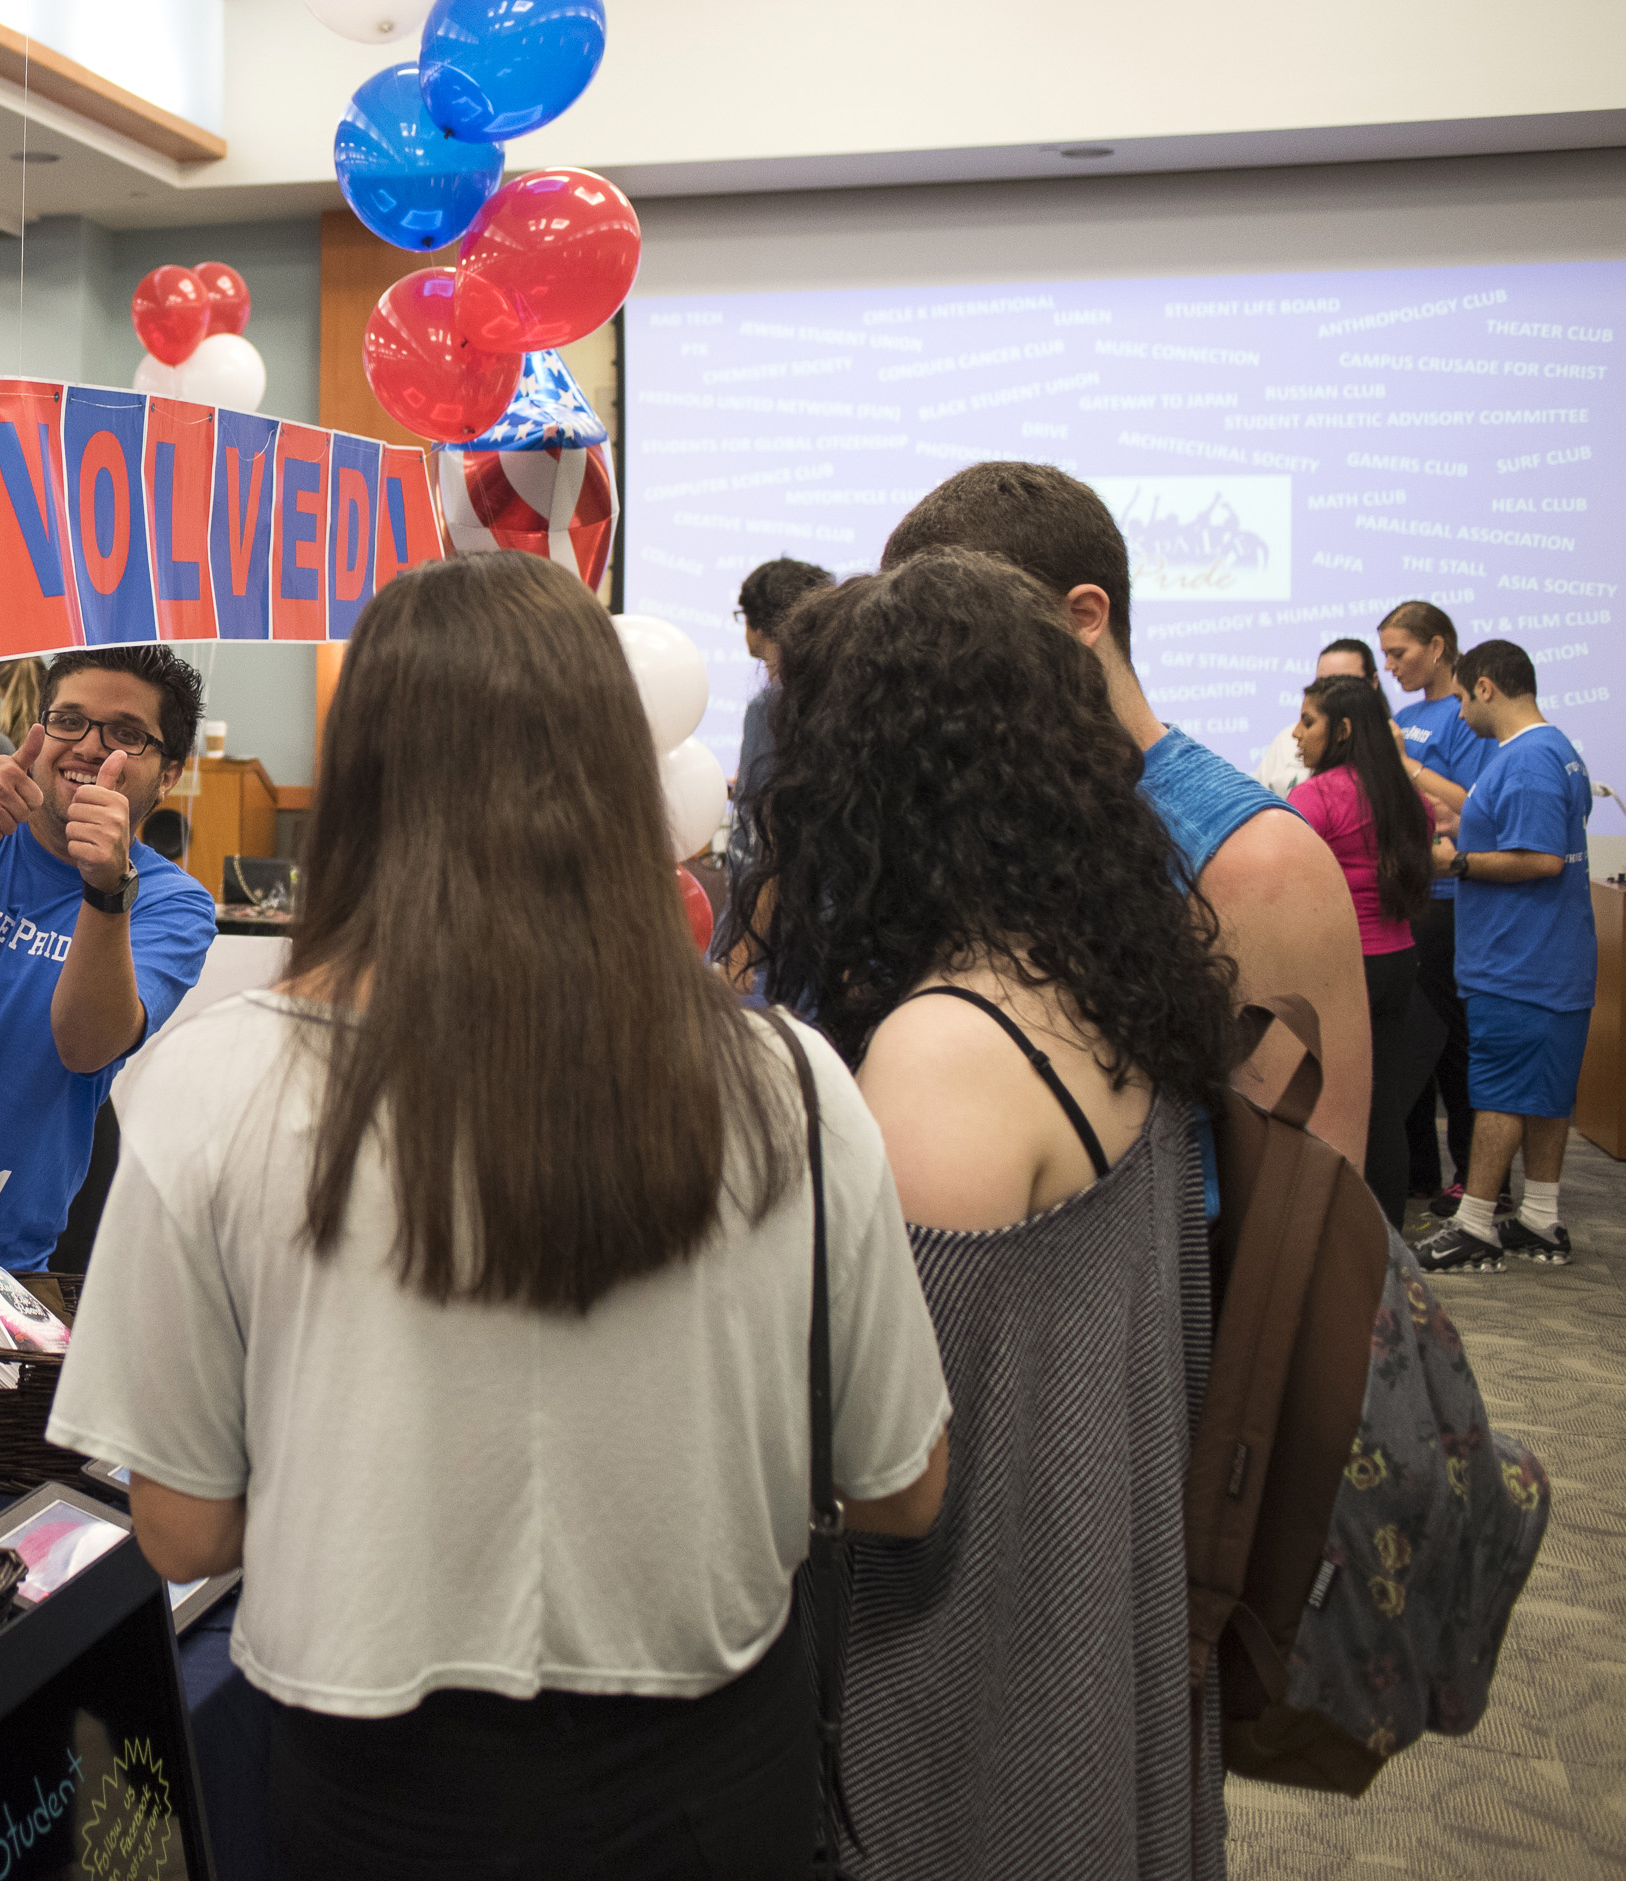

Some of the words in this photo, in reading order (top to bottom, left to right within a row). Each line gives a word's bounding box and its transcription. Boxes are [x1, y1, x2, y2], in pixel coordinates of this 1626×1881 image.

[685, 310, 723, 325] TECH
[863, 306, 912, 326] CIRCLE
[931, 294, 1056, 320] INTERNATIONAL
[1054, 309, 1112, 326] LUMEN
[1164, 301, 1239, 319] STUDENT
[1243, 301, 1275, 317] LIFE
[1280, 297, 1341, 315] BOARD
[1317, 298, 1459, 340] ANTHROPOLOGY
[1463, 288, 1508, 310] CLUB
[798, 327, 866, 346] STUDENT
[870, 333, 923, 352] UNION
[1486, 318, 1563, 339] THEATER
[1567, 325, 1614, 343] CLUB
[878, 356, 956, 383] CONQUER
[958, 346, 1021, 370] CANCER
[1024, 338, 1065, 358] CLUB
[1095, 338, 1148, 359] MUSIC
[1152, 343, 1261, 367] CONNECTION
[703, 362, 786, 385] CHEMISTRY
[791, 356, 853, 376] SOCIETY
[1339, 352, 1414, 372] CAMPUS
[1418, 356, 1499, 375] CRUSADE
[1504, 360, 1539, 377] FOR
[1544, 363, 1608, 381] CHRIST
[918, 399, 966, 421] BLACK
[970, 382, 1041, 412] STUDENT
[1045, 371, 1100, 396] UNION
[1079, 394, 1157, 411] GATEWAY
[1161, 394, 1182, 410] TO
[1186, 393, 1238, 409] JAPAN
[1265, 384, 1339, 401] RUSSIAN
[1343, 383, 1386, 400] CLUB
[718, 395, 773, 412] UNITED
[777, 398, 853, 418] NETWORK
[857, 402, 902, 423] (FUN)
[1224, 413, 1301, 432] STUDENT
[1305, 412, 1382, 429] ATHLETIC
[1387, 410, 1474, 427] ADVISORY
[1480, 407, 1590, 426] COMMITTEE
[1022, 421, 1070, 440] DRIVE
[642, 438, 718, 455] STUDENTS
[721, 437, 751, 452] FOR
[754, 436, 812, 452] GLOBAL
[816, 433, 909, 451] CITIZENSHIP
[1118, 430, 1247, 465] ARCHITECTURAL
[1252, 450, 1320, 475] SOCIETY
[1347, 451, 1420, 473] GAMERS
[1424, 459, 1469, 477] CLUB
[1496, 453, 1542, 475] SURF
[1546, 445, 1593, 466] CLUB
[644, 477, 728, 502] COMPUTER
[731, 467, 792, 490] SCIENCE
[795, 462, 834, 481] CLUB
[785, 489, 886, 506] MOTORCYCLE
[1308, 492, 1359, 511] MATH
[1362, 488, 1407, 507] CLUB
[1491, 497, 1537, 513] HEAL
[1541, 497, 1588, 512] CLUB
[673, 511, 741, 531] CREATIVE
[745, 518, 813, 540] WRITING
[816, 525, 855, 543] CLUB
[1355, 514, 1453, 540] PARALEGAL
[1456, 524, 1575, 551] ASSOCIATION
[1312, 551, 1364, 573] ALPFA
[1402, 555, 1435, 573] THE
[1439, 557, 1489, 577] STALL
[1497, 574, 1539, 591] ASIA
[1544, 577, 1618, 598] SOCIETY
[1147, 613, 1254, 641] PSYCHOLOGY
[1259, 610, 1272, 627] &
[1277, 601, 1344, 625] HUMAN
[1430, 587, 1475, 606] CLUB
[1470, 618, 1494, 635] TV
[1498, 616, 1512, 632] &
[1518, 613, 1560, 630] FILM
[1565, 609, 1611, 628] CLUB
[1161, 650, 1194, 668] GAY
[1198, 652, 1280, 672] STRAIGHT
[1148, 680, 1257, 704] ASSOCIATION
[1564, 687, 1610, 708] CLUB
[1206, 716, 1249, 733] CLUB
[94, 1817, 122, 1877] Follow
[123, 1784, 136, 1811] us
